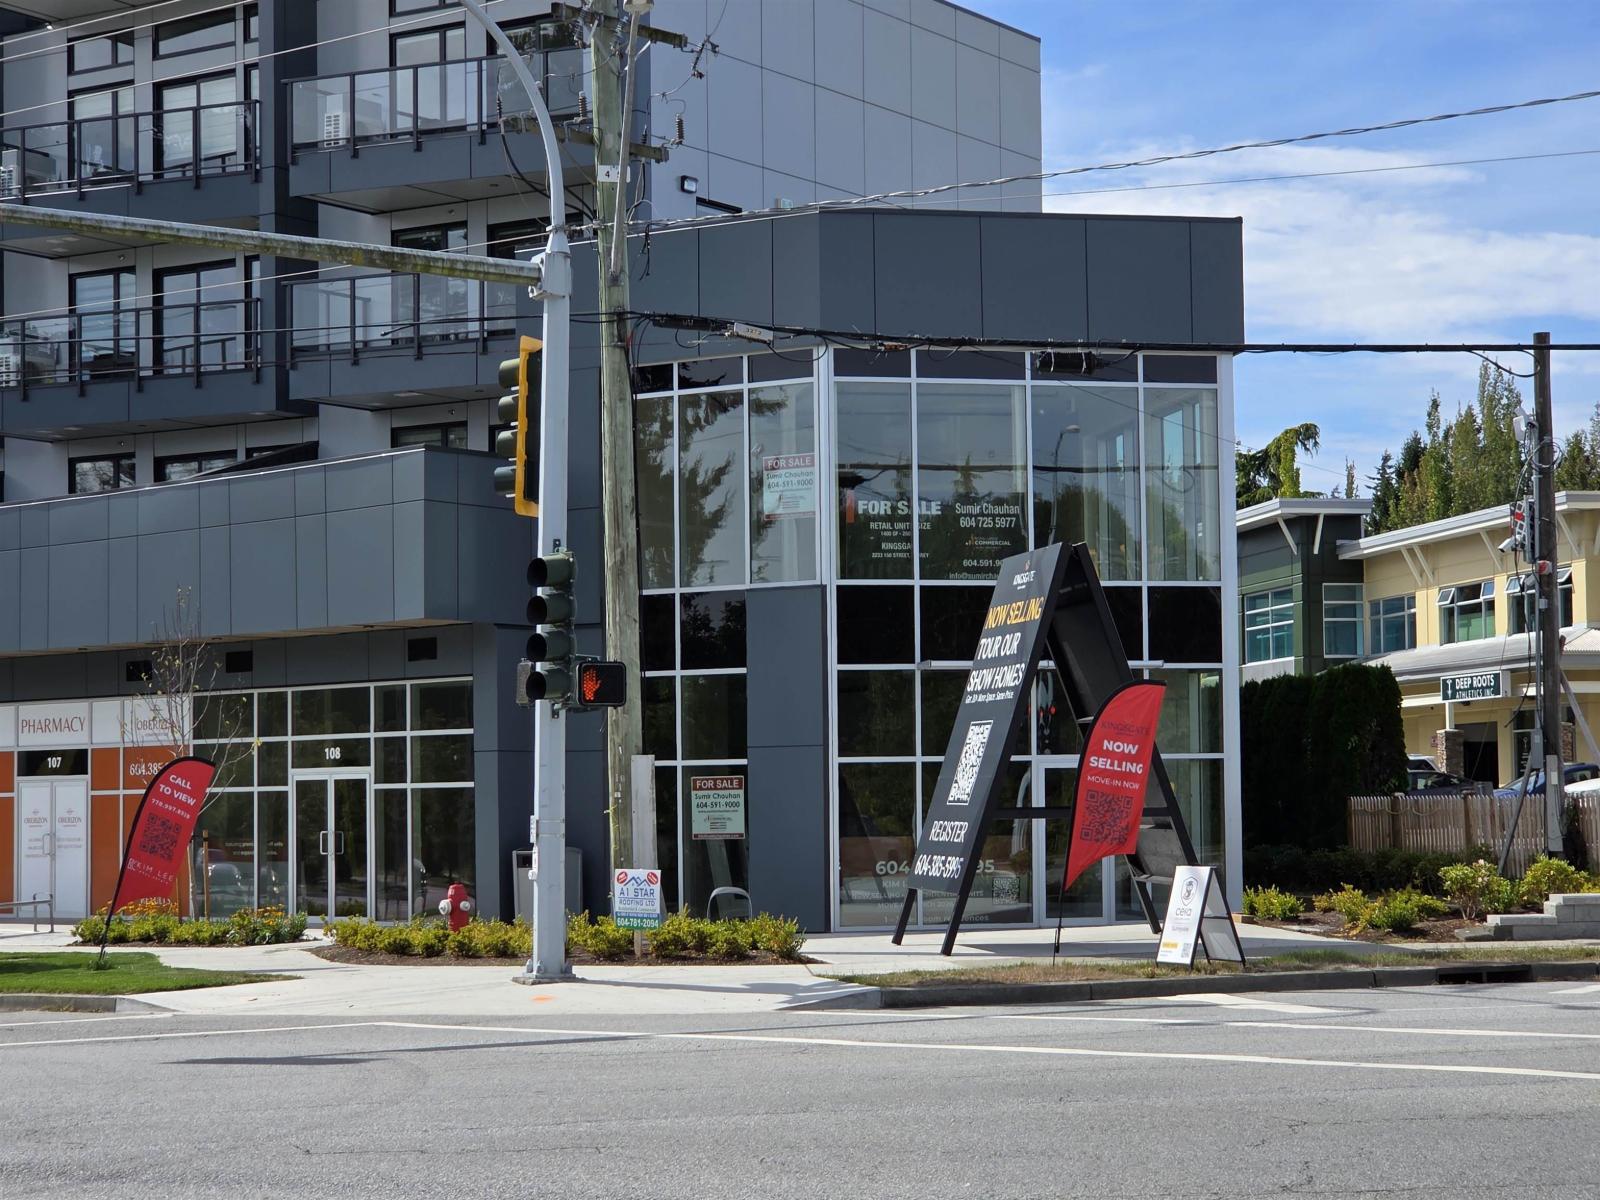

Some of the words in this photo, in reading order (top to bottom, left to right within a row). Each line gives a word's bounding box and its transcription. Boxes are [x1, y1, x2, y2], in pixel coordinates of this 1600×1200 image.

[767, 459, 786, 469] FOR
[788, 456, 812, 467] SALE
[857, 500, 892, 514] FOR
[955, 503, 980, 514] Sumir
[982, 503, 1020, 514] Chauhan
[960, 517, 976, 527] 604
[978, 517, 993, 527] 725
[995, 517, 1016, 528] 5977
[985, 604, 1010, 629] NOW
[1007, 597, 1045, 625] SELLING
[978, 635, 1003, 660] TOUR
[1001, 632, 1021, 657] OUR
[967, 667, 996, 692] SHOW
[991, 663, 1025, 689] HOMES
[1455, 677, 1472, 690] DEEP
[1472, 674, 1495, 688] ROOTS
[1455, 688, 1483, 700] ATHLETICS
[21, 716, 86, 734] PHARMACY
[324, 746, 341, 760] 108
[1103, 740, 1139, 755] NOW
[47, 756, 62, 769] 107
[1089, 757, 1144, 775] SELLING
[169, 774, 192, 790] CALL
[696, 780, 715, 789] FOR
[716, 778, 740, 789] SALE
[1087, 776, 1121, 787] MOVE-IN
[1122, 781, 1140, 790] NOW
[159, 784, 172, 796] TO
[173, 790, 197, 806] VIEW
[712, 792, 741, 800] Chauhan
[695, 800, 741, 809] 604-591-9000
[928, 821, 969, 843] REGISTER
[914, 854, 964, 880] 604-385-5995
[157, 871, 174, 882] LEE
[633, 887, 655, 898] STAR
[618, 899, 644, 907] ROOFING
[616, 917, 659, 928] 604-781-2094
